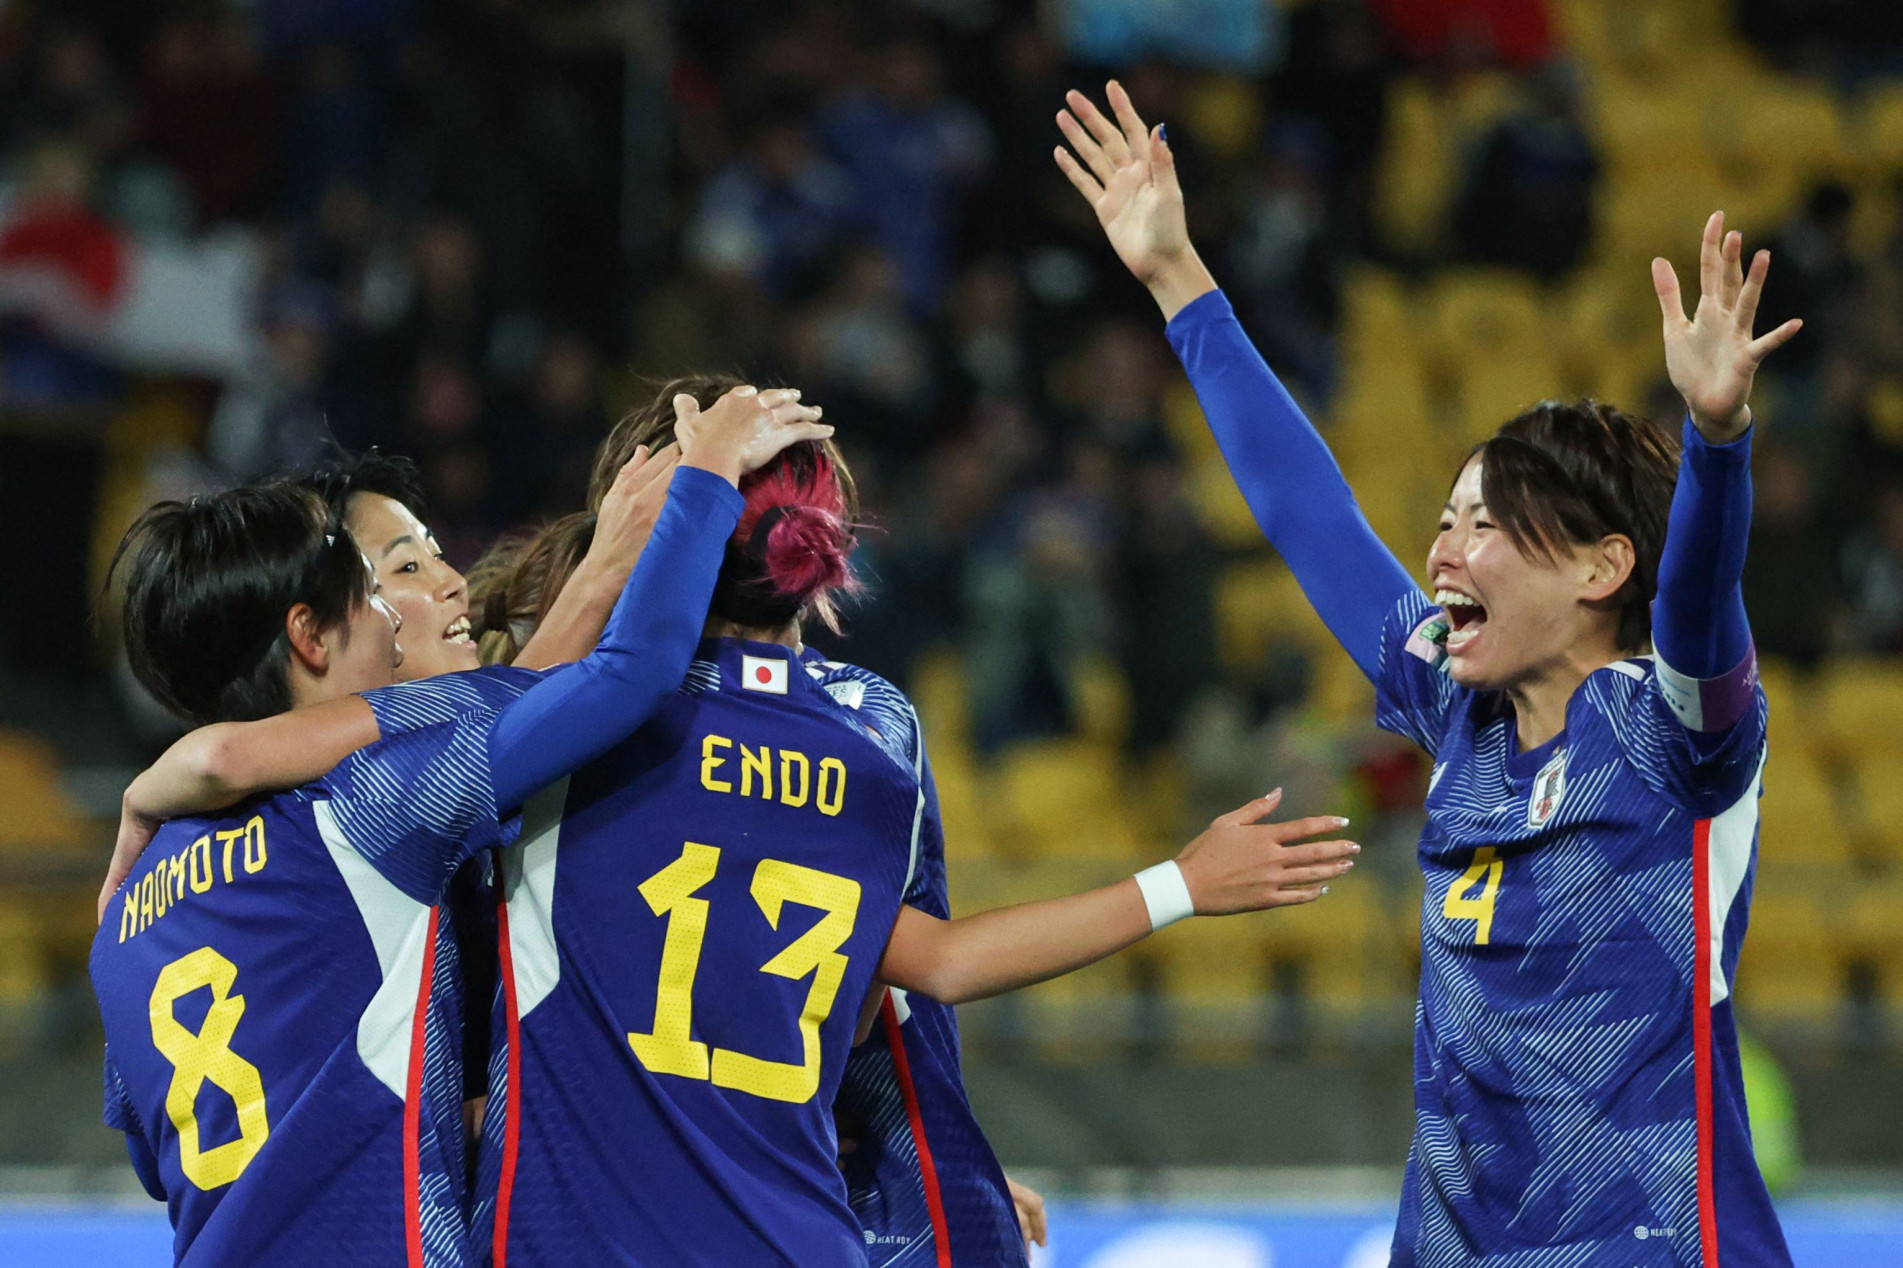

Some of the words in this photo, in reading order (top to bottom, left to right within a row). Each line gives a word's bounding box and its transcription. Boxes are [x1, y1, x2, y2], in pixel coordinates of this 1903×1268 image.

[700, 734, 847, 817] ENDO
[118, 815, 268, 944] NAOMOTO
[1442, 847, 1504, 945] 4
[627, 841, 862, 1104] 13
[149, 946, 270, 1191] 8
